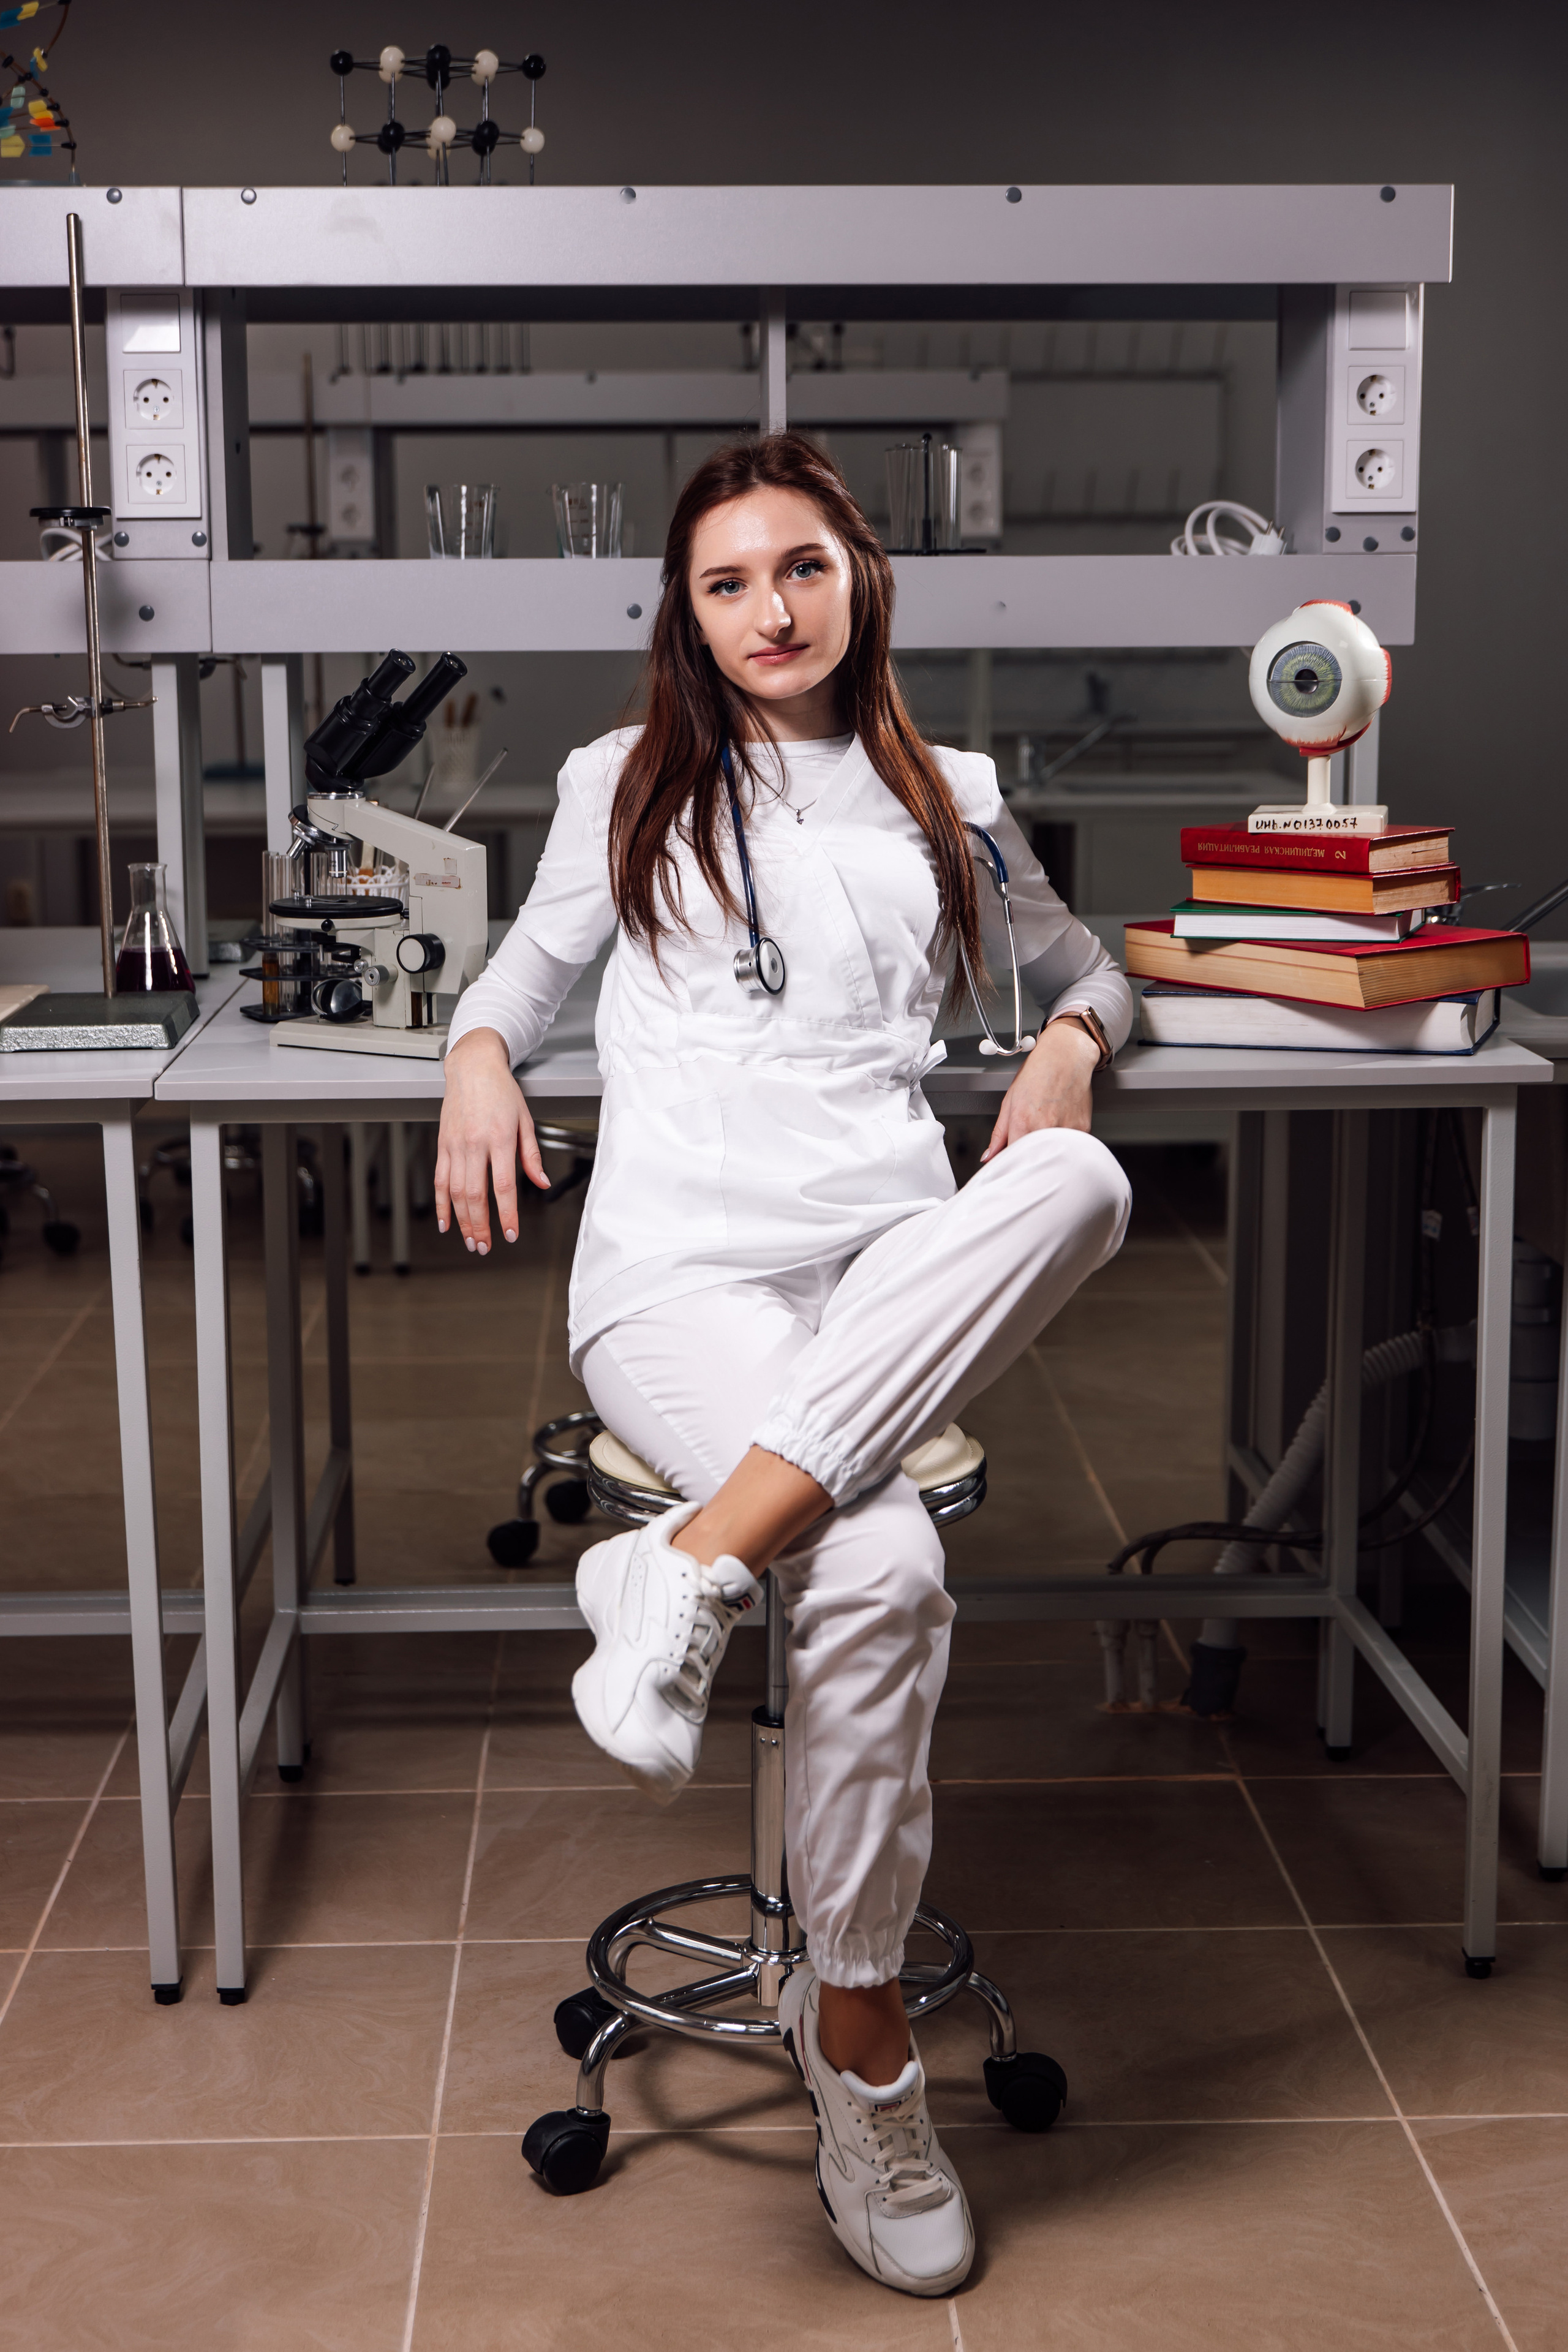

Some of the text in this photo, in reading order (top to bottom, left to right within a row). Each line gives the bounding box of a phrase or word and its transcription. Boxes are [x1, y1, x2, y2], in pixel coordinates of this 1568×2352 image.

[1197, 842, 1325, 858] МЕДИЦИНСКАЯ РЕАБИЛИТАЦИЯ
[1335, 850, 1347, 859] 2
